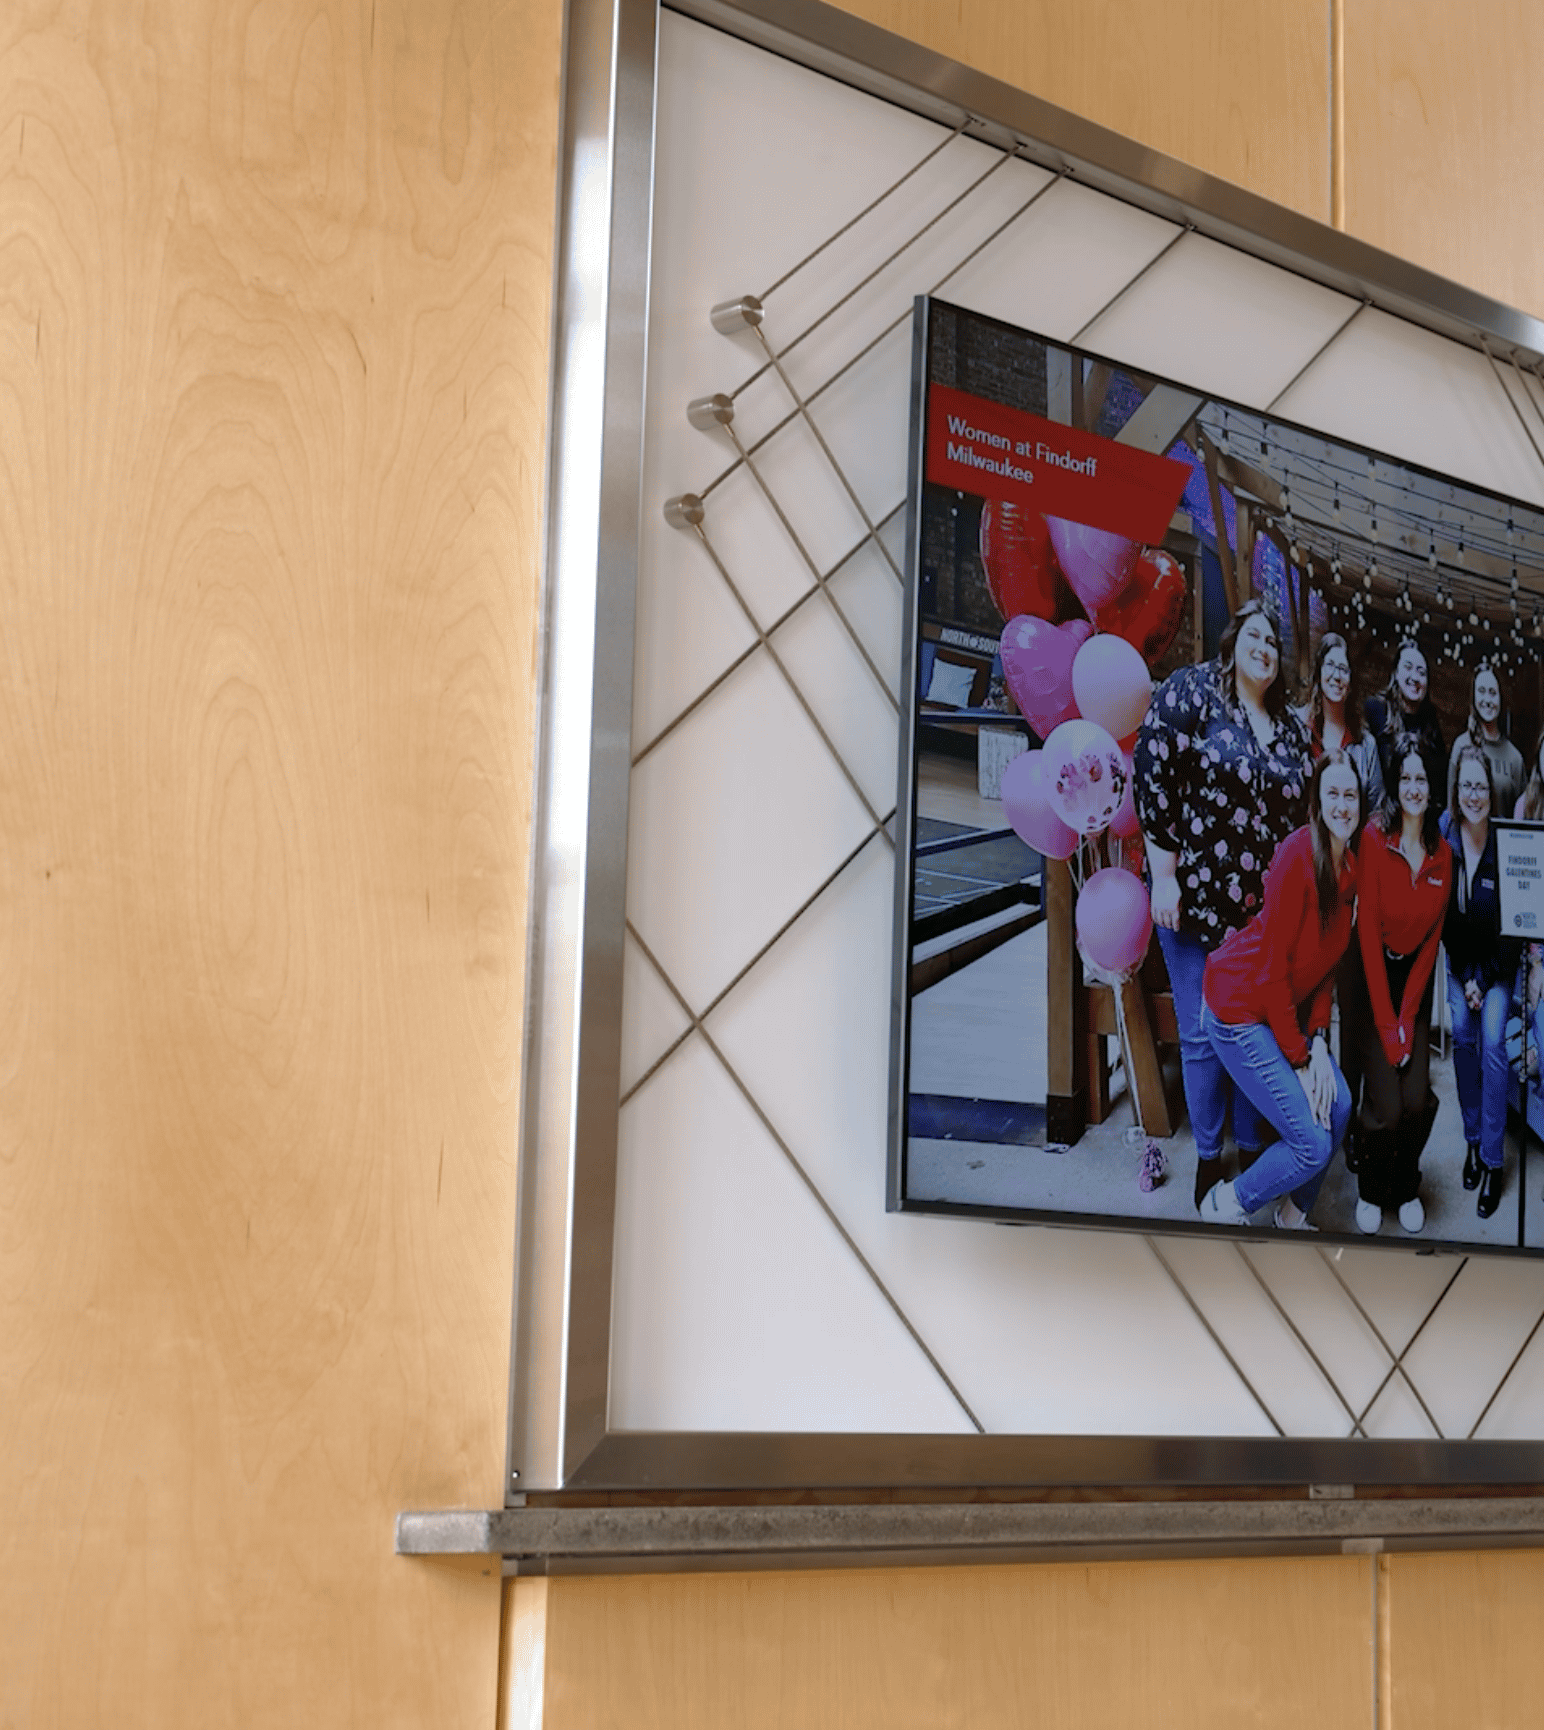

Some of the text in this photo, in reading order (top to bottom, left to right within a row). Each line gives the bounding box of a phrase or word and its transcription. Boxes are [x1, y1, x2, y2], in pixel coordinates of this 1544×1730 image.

[946, 441, 1034, 483] Milwaukee
[947, 414, 1098, 477] Women at Findorff
[940, 628, 1000, 654] NORTH SOUT
[1517, 880, 1531, 890] DAY
